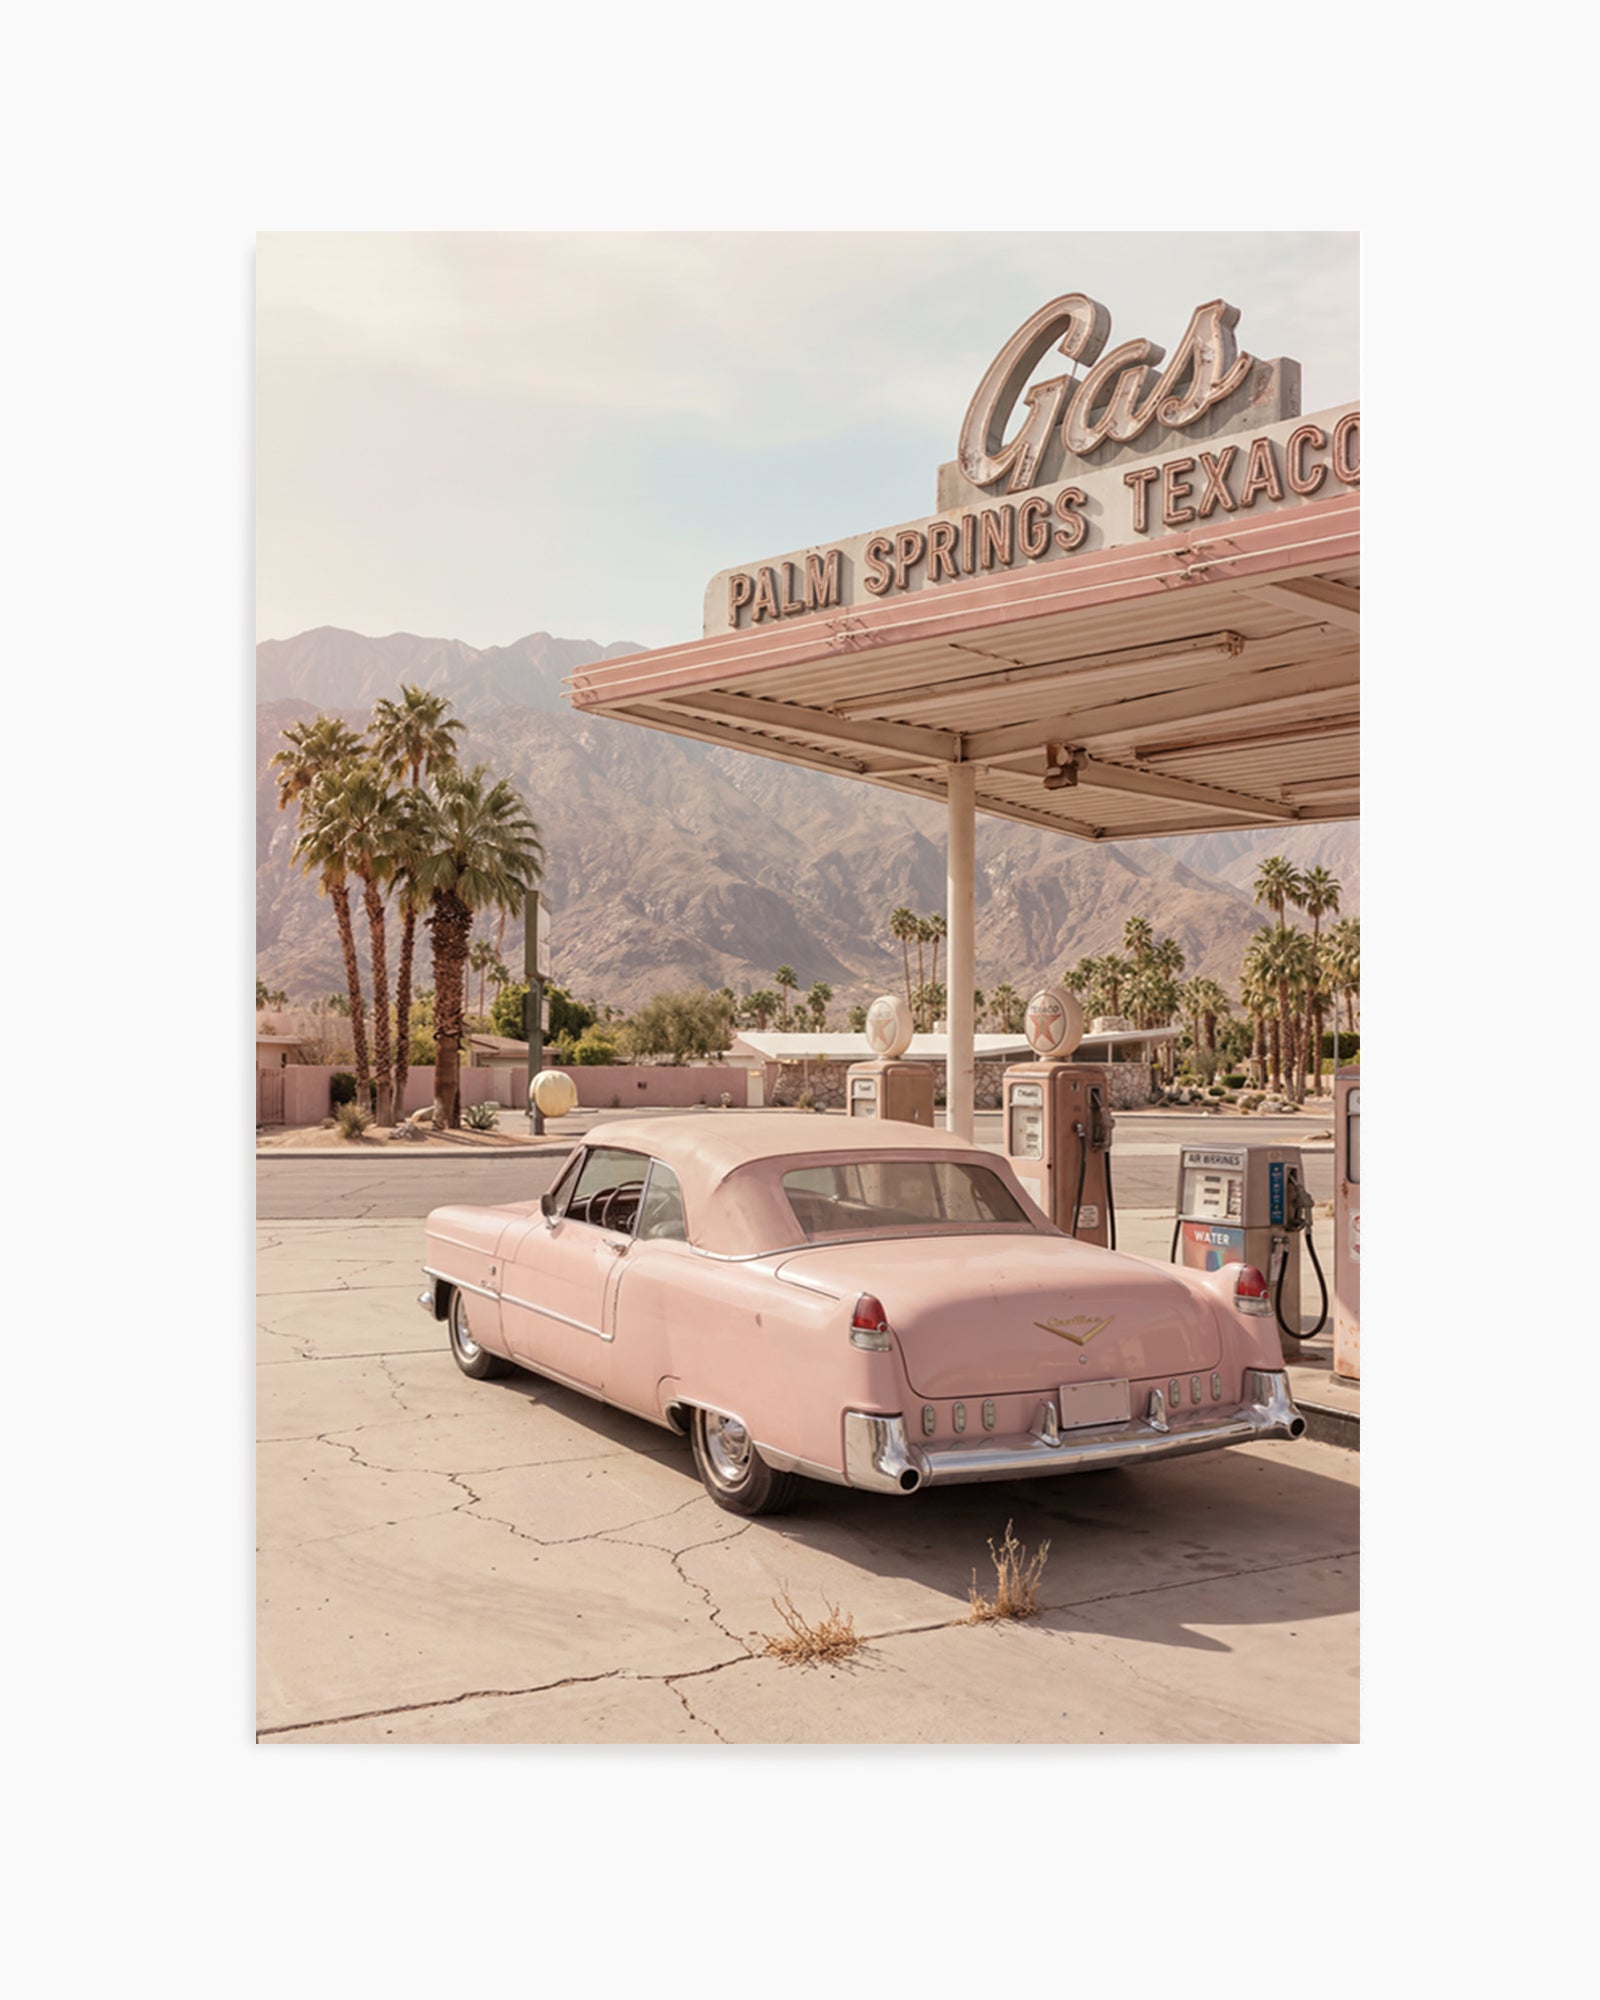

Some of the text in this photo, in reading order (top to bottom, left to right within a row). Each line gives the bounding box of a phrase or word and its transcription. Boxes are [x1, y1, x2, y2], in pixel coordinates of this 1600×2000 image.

[958, 293, 1253, 496] Gas
[728, 411, 1360, 627] PALM SPRINGS TEXACO
[1193, 1230, 1230, 1246] WATER
